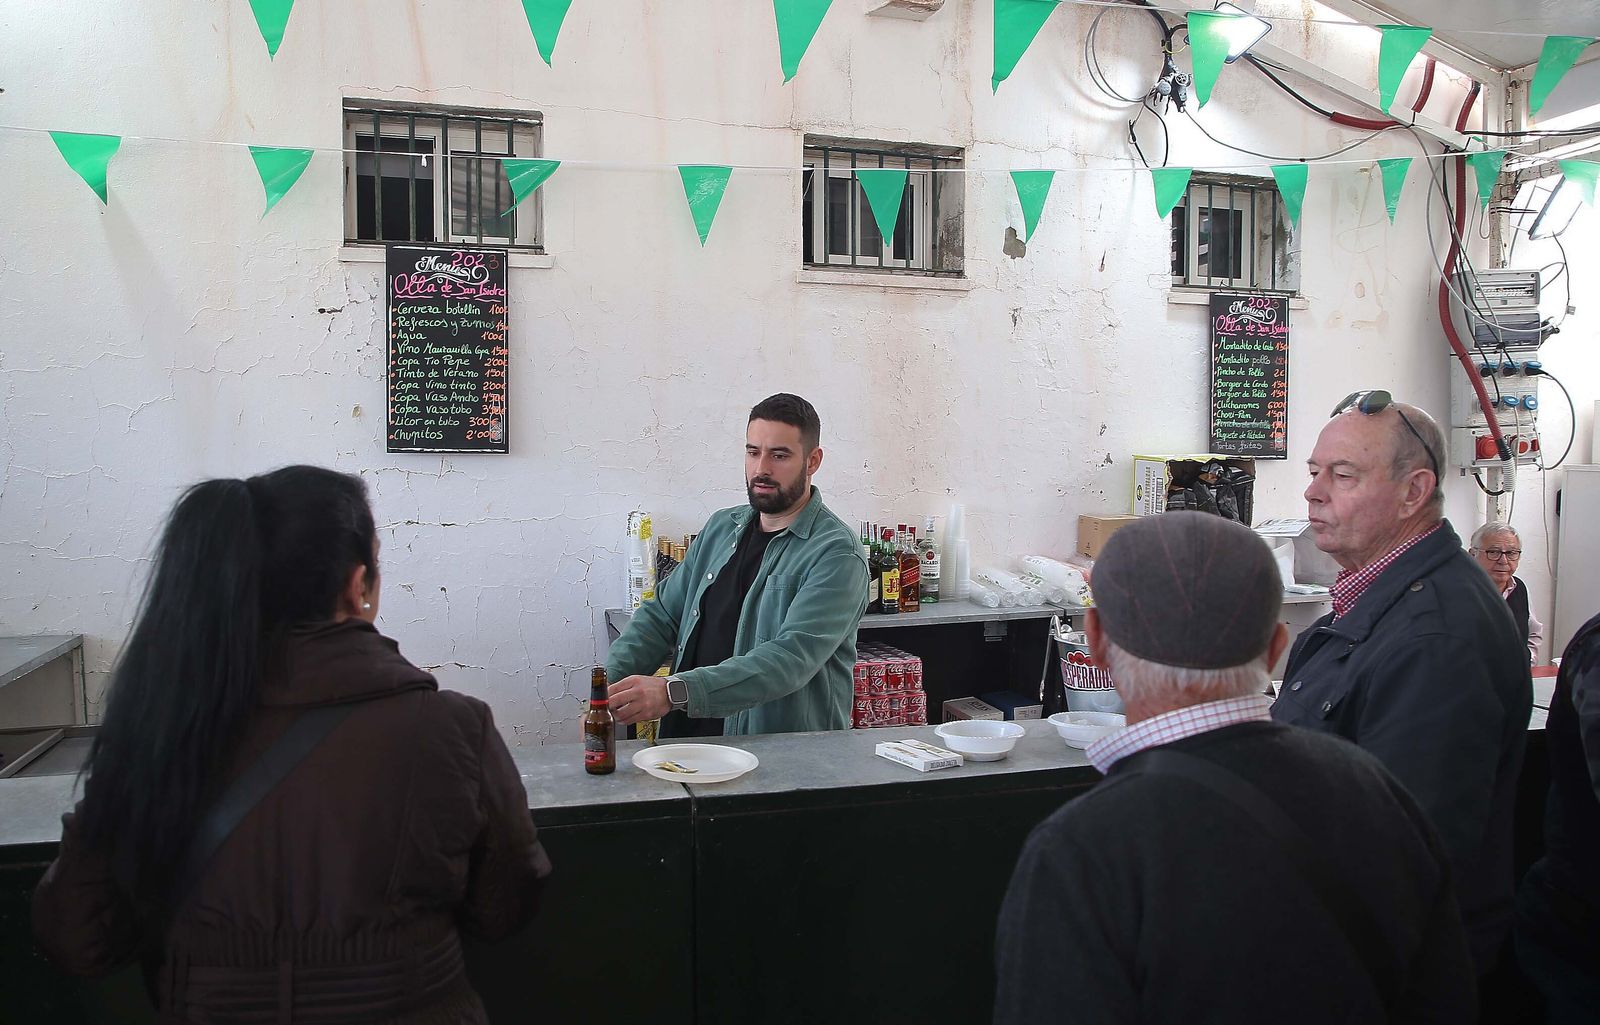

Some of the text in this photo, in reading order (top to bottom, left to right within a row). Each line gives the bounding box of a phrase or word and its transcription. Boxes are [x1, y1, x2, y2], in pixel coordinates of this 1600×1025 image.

[451, 252, 499, 269] 2023
[394, 274, 506, 298] Olla de San Isidro
[397, 302, 442, 315] Cerveza
[396, 317, 448, 332] Refrescos
[450, 321, 458, 336] y
[1216, 315, 1242, 332] Olla
[1246, 320, 1256, 332] de
[396, 329, 426, 344] Agua
[1218, 336, 1252, 350] Montadito
[1254, 340, 1262, 350] de
[397, 342, 420, 354] Vino
[474, 345, 490, 360] Copa
[397, 356, 420, 370] Copa
[442, 354, 470, 370] Pepe
[1216, 353, 1250, 364] Montadito
[396, 368, 425, 378] Tinto
[428, 369, 440, 378] de
[443, 368, 479, 378] Verano
[1216, 366, 1236, 377] Pincho
[1236, 367, 1246, 375] de
[1248, 368, 1264, 377] Pollo
[396, 380, 420, 394] Copa
[449, 380, 476, 390] tinto
[1243, 380, 1250, 388] de
[394, 392, 420, 407] Copa
[449, 391, 479, 402] Ancho
[1242, 390, 1250, 398] de
[1252, 389, 1266, 398] Pollo
[394, 404, 421, 418] Copa
[450, 404, 472, 414] tubo
[394, 416, 423, 426] Licor
[438, 416, 460, 426] tubo
[394, 427, 444, 446] Chupitos
[1215, 428, 1238, 441] Paquete
[1216, 442, 1236, 450] Tortas
